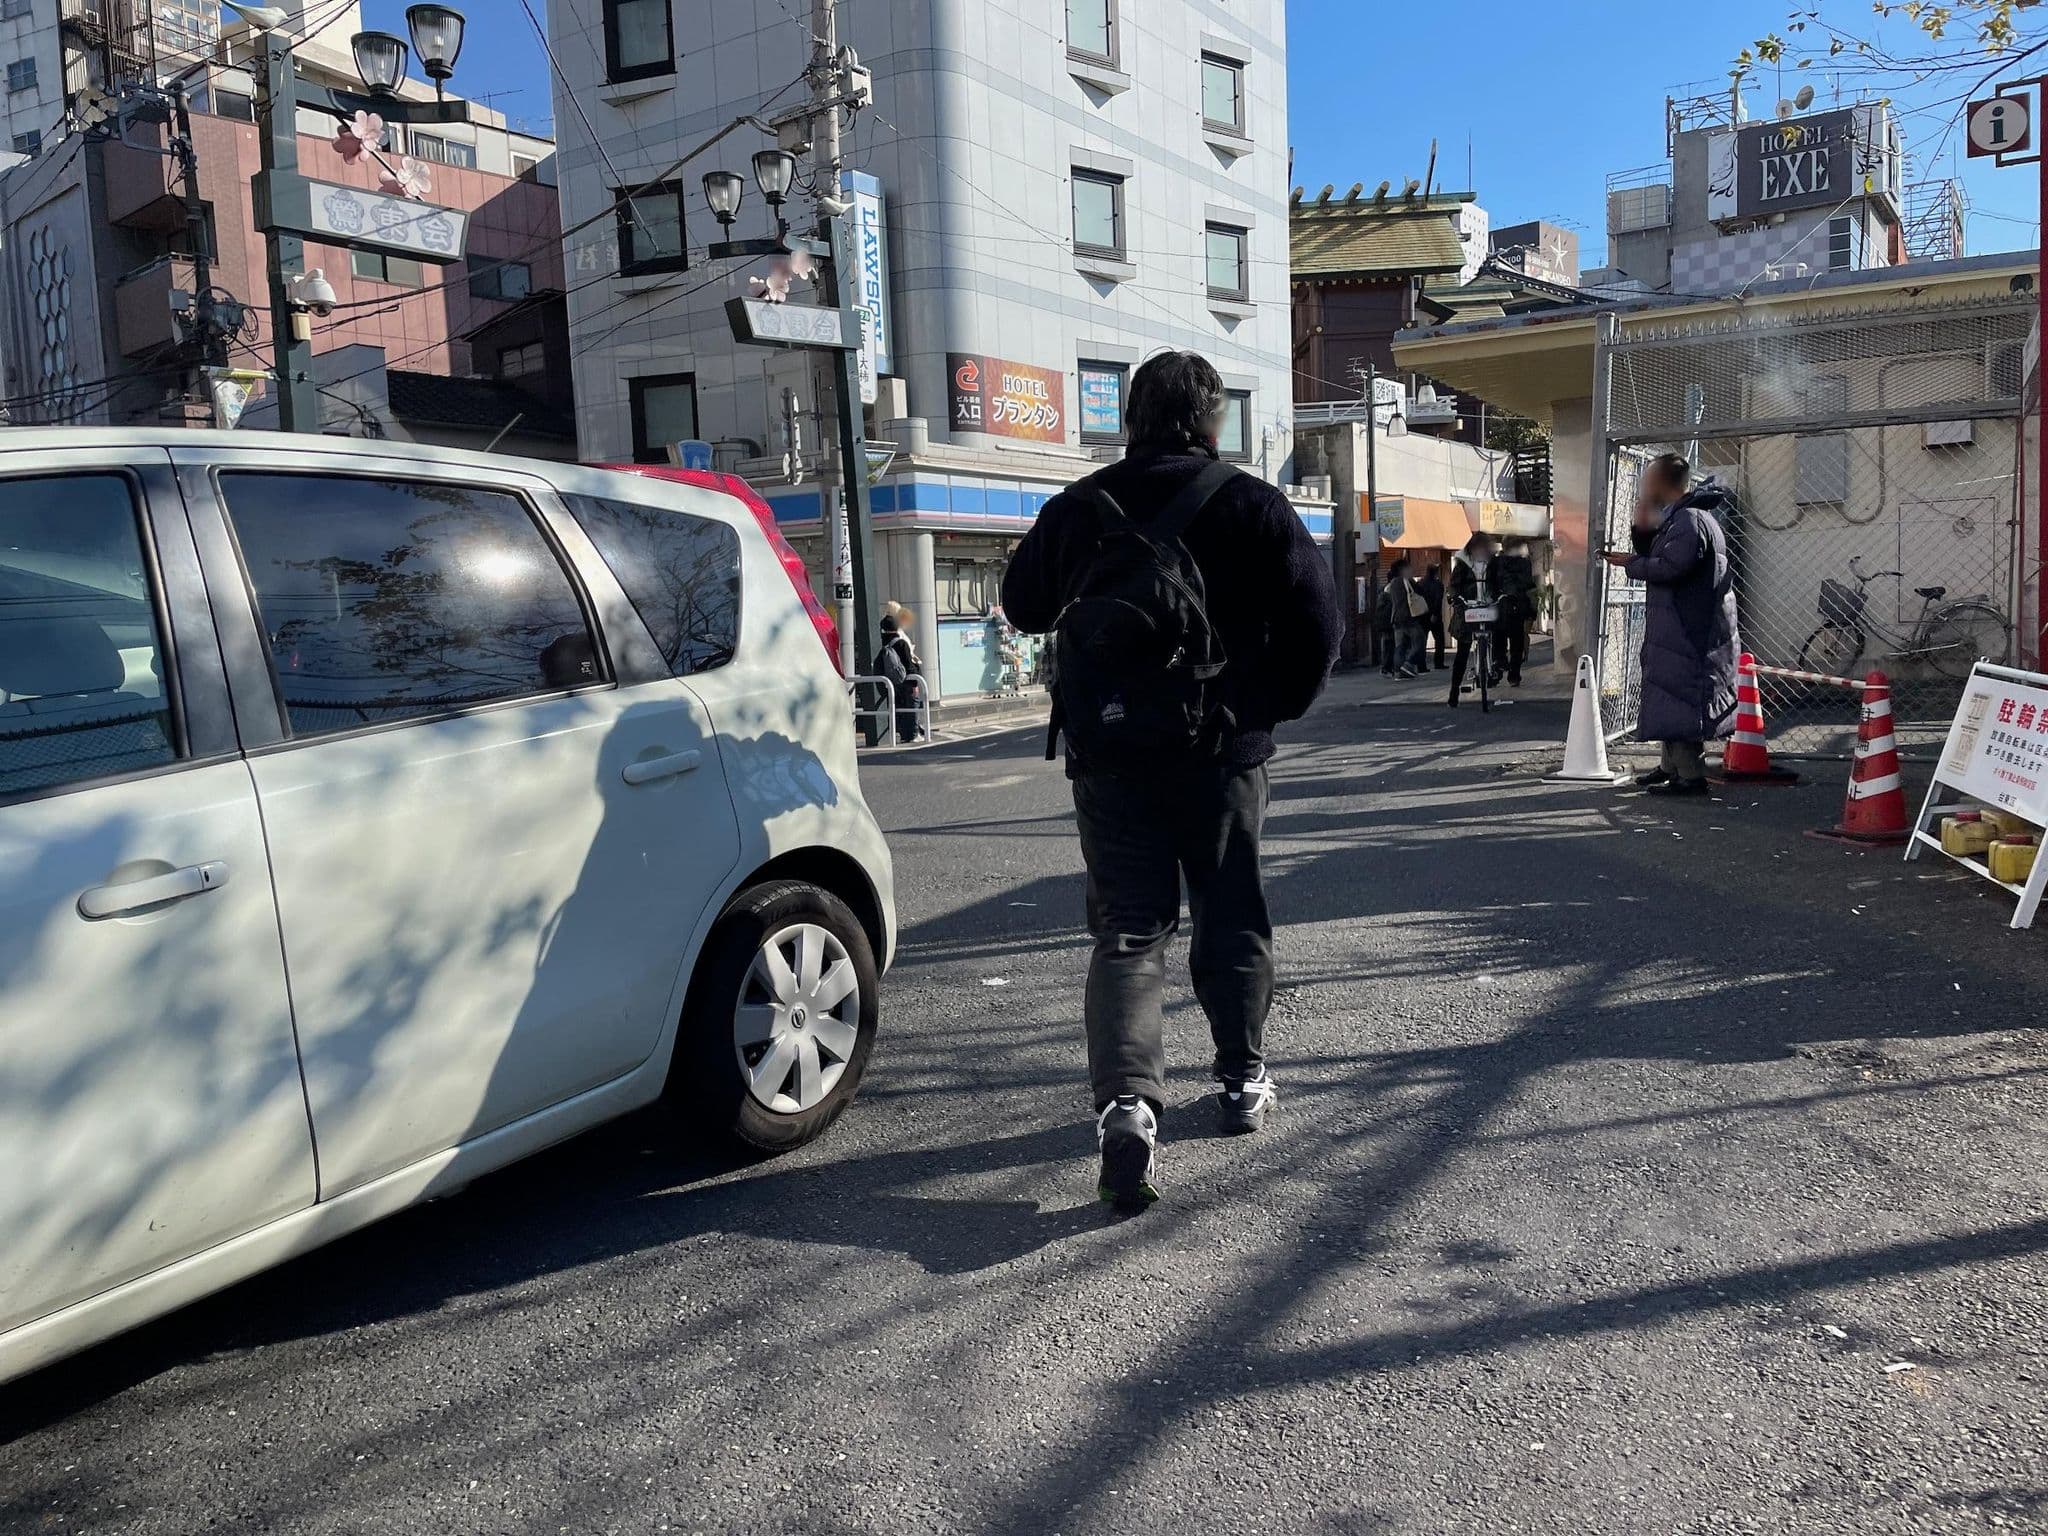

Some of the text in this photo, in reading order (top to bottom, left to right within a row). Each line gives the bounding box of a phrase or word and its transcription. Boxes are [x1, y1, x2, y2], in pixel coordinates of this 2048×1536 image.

[1759, 147, 1829, 200] EXE
[1003, 375, 1048, 399] HOTEL
[957, 403, 981, 419] 入口
[993, 396, 1059, 429] プランタン
